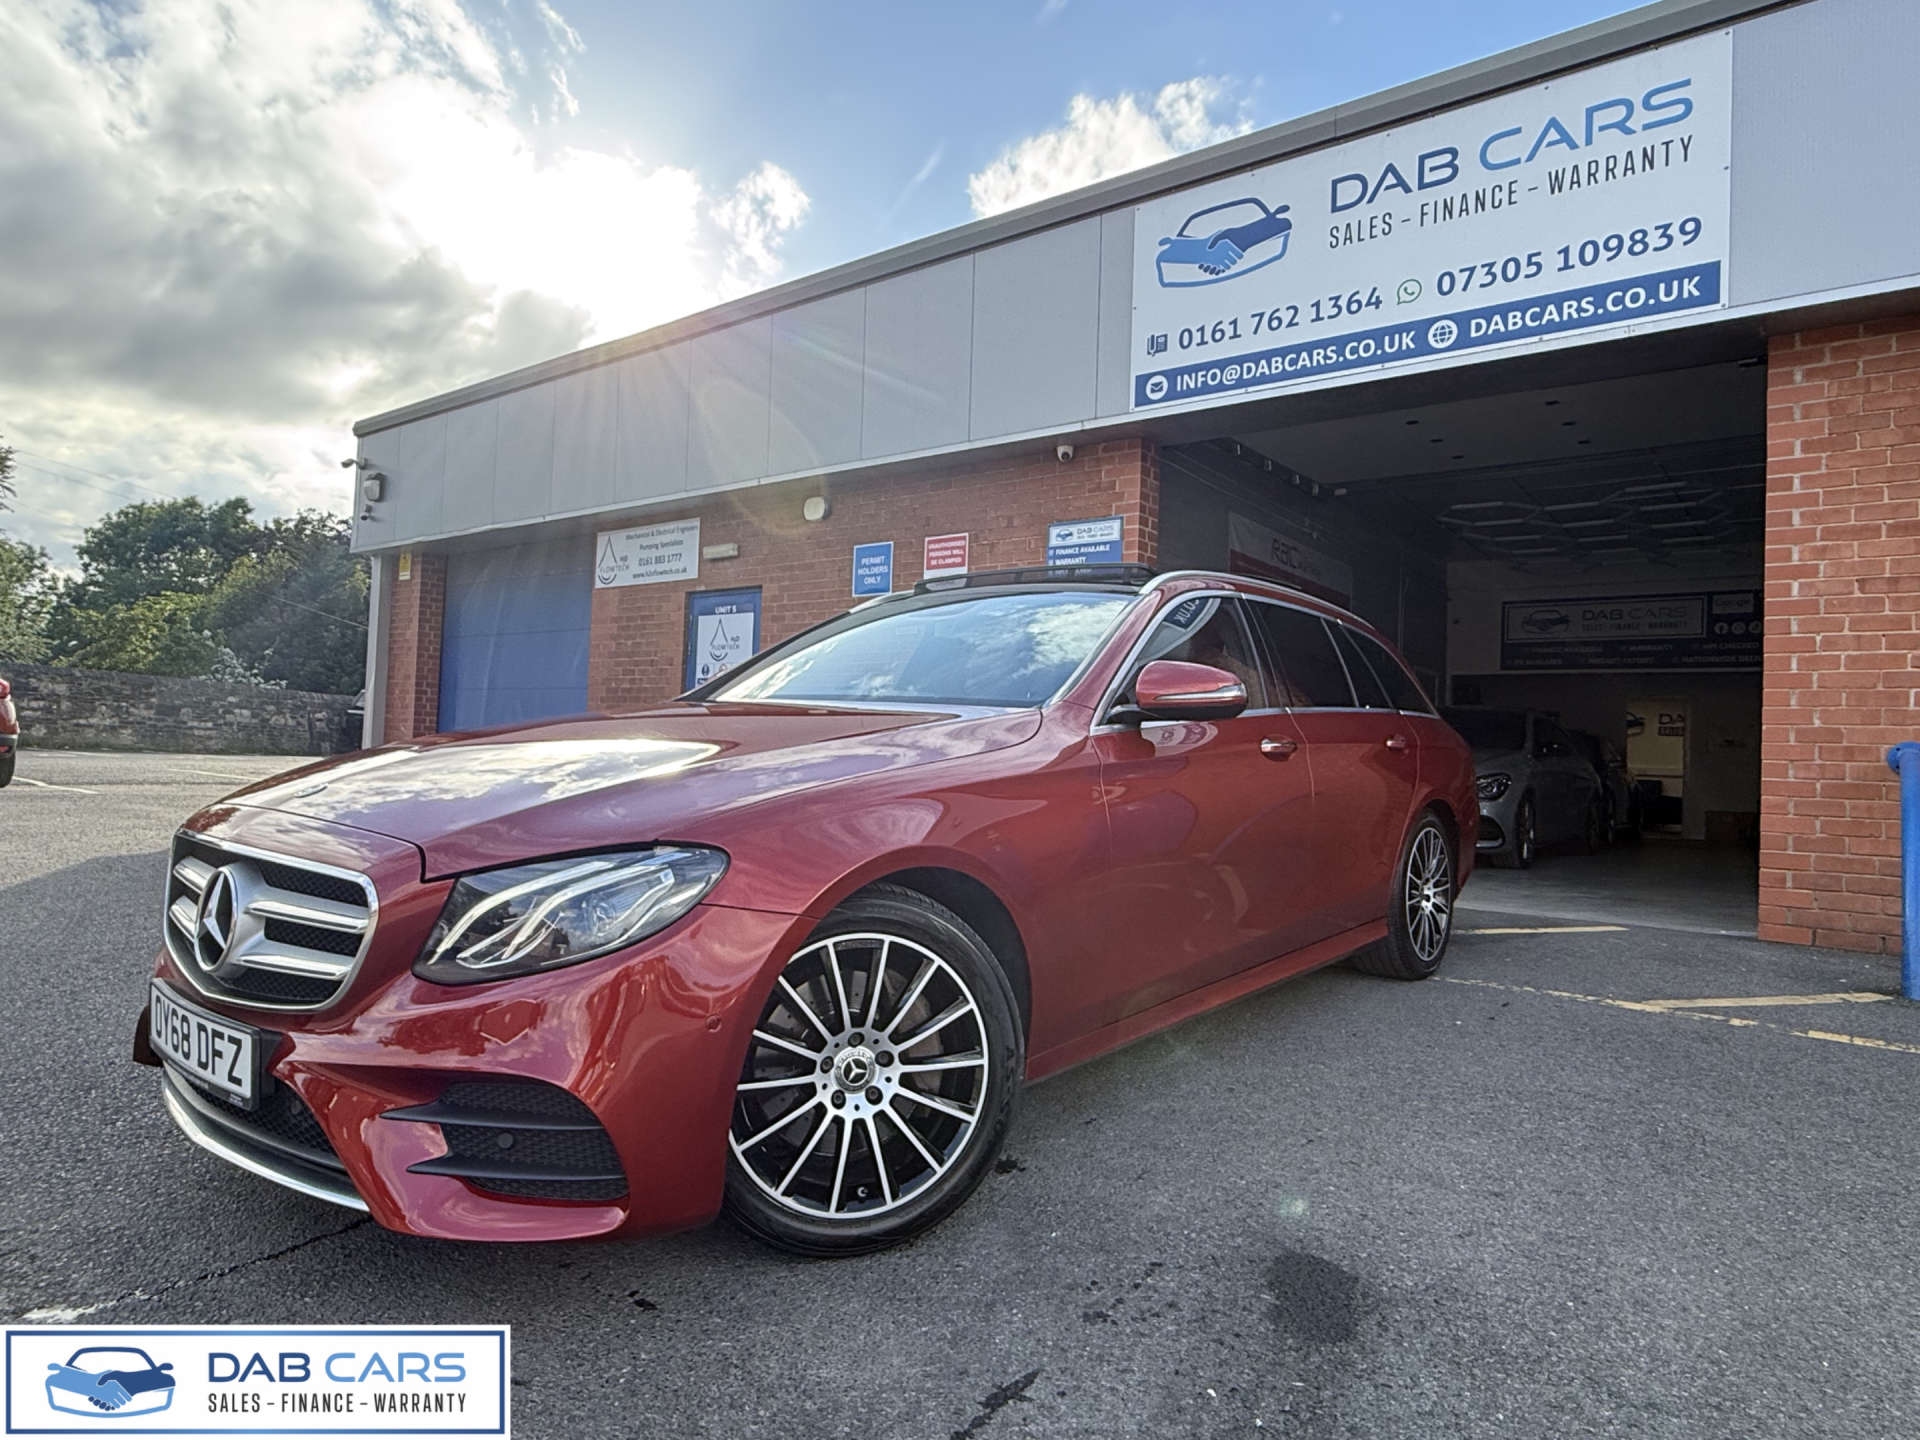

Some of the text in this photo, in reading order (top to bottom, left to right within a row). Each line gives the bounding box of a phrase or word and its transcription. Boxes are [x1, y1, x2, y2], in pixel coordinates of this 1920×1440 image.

[1330, 78, 1694, 214] DAB CARS
[1329, 212, 1393, 250] SALES
[1418, 180, 1518, 228] FINANCE
[1547, 135, 1694, 195] WARRANTY
[1177, 216, 1703, 351] 0161 762 1364 07305 109839
[1176, 275, 1702, 393] INFO@DABCARS.CO.UK DABCARS.CO.UK
[1080, 544, 1111, 553] AVAILABLE
[667, 552, 682, 563] 1777
[860, 555, 885, 565] PERMIT
[1055, 556, 1087, 566] WARRANTY
[857, 565, 889, 576] HOLDERS
[863, 576, 882, 585] ONLY
[715, 605, 731, 614] UNIT
[1582, 606, 1688, 621] DAB CARS
[155, 995, 243, 1088] OY68 DFZ
